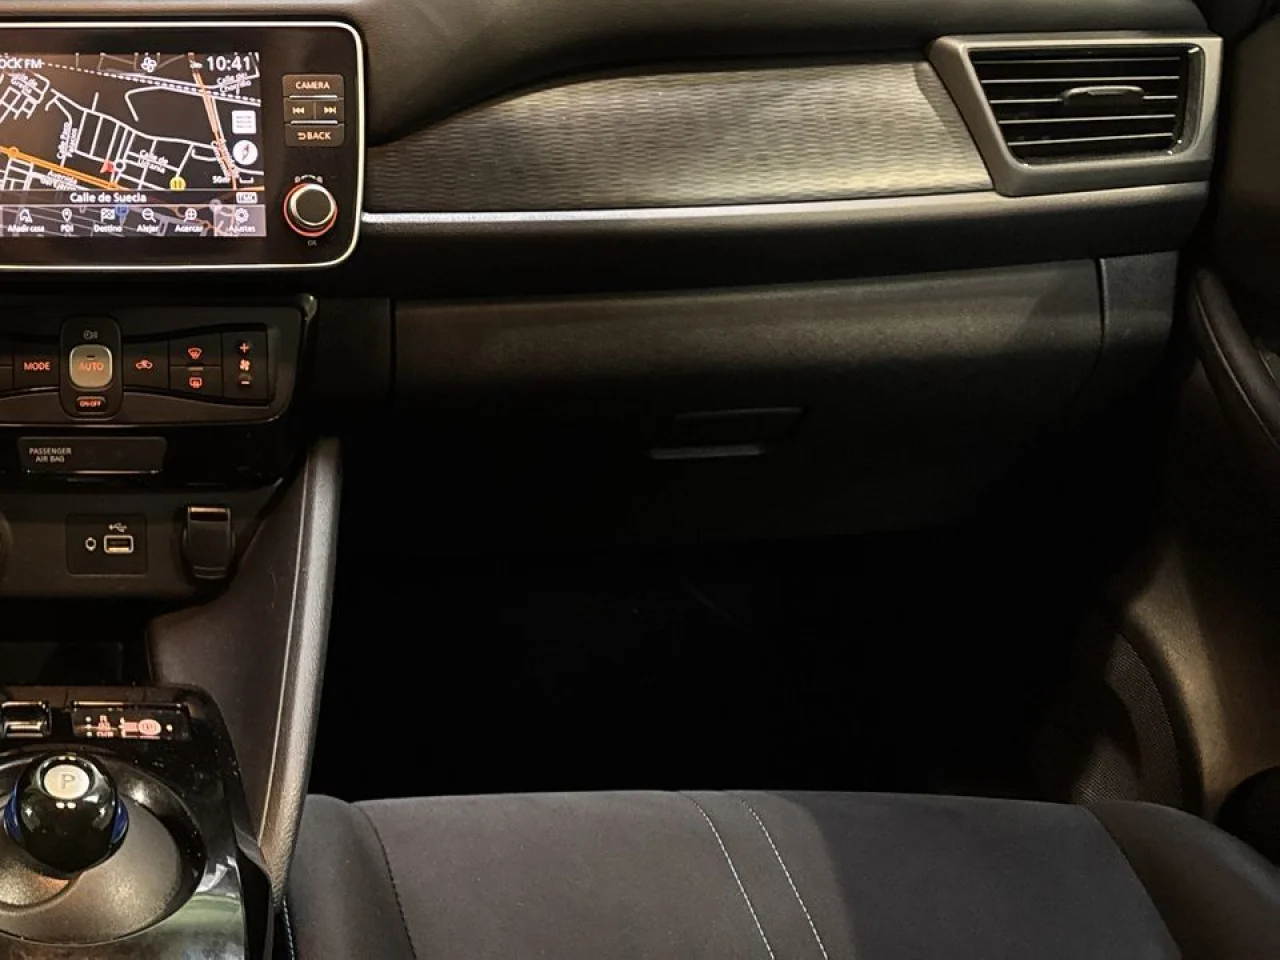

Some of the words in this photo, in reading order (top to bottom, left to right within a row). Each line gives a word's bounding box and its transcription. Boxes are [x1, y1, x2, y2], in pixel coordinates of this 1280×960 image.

[24, 59, 42, 69] FM
[206, 55, 251, 71] 10:41
[295, 81, 331, 90] CAMERA
[307, 132, 331, 140] BACK
[70, 192, 96, 203] Calle
[98, 192, 112, 203] de
[113, 192, 147, 203] Suecia
[94, 224, 122, 233] Destino
[136, 224, 159, 234] Alejar
[175, 224, 203, 233] Acercar
[23, 361, 52, 371] MODE
[79, 362, 105, 372] AUTO
[60, 773, 76, 790] P
